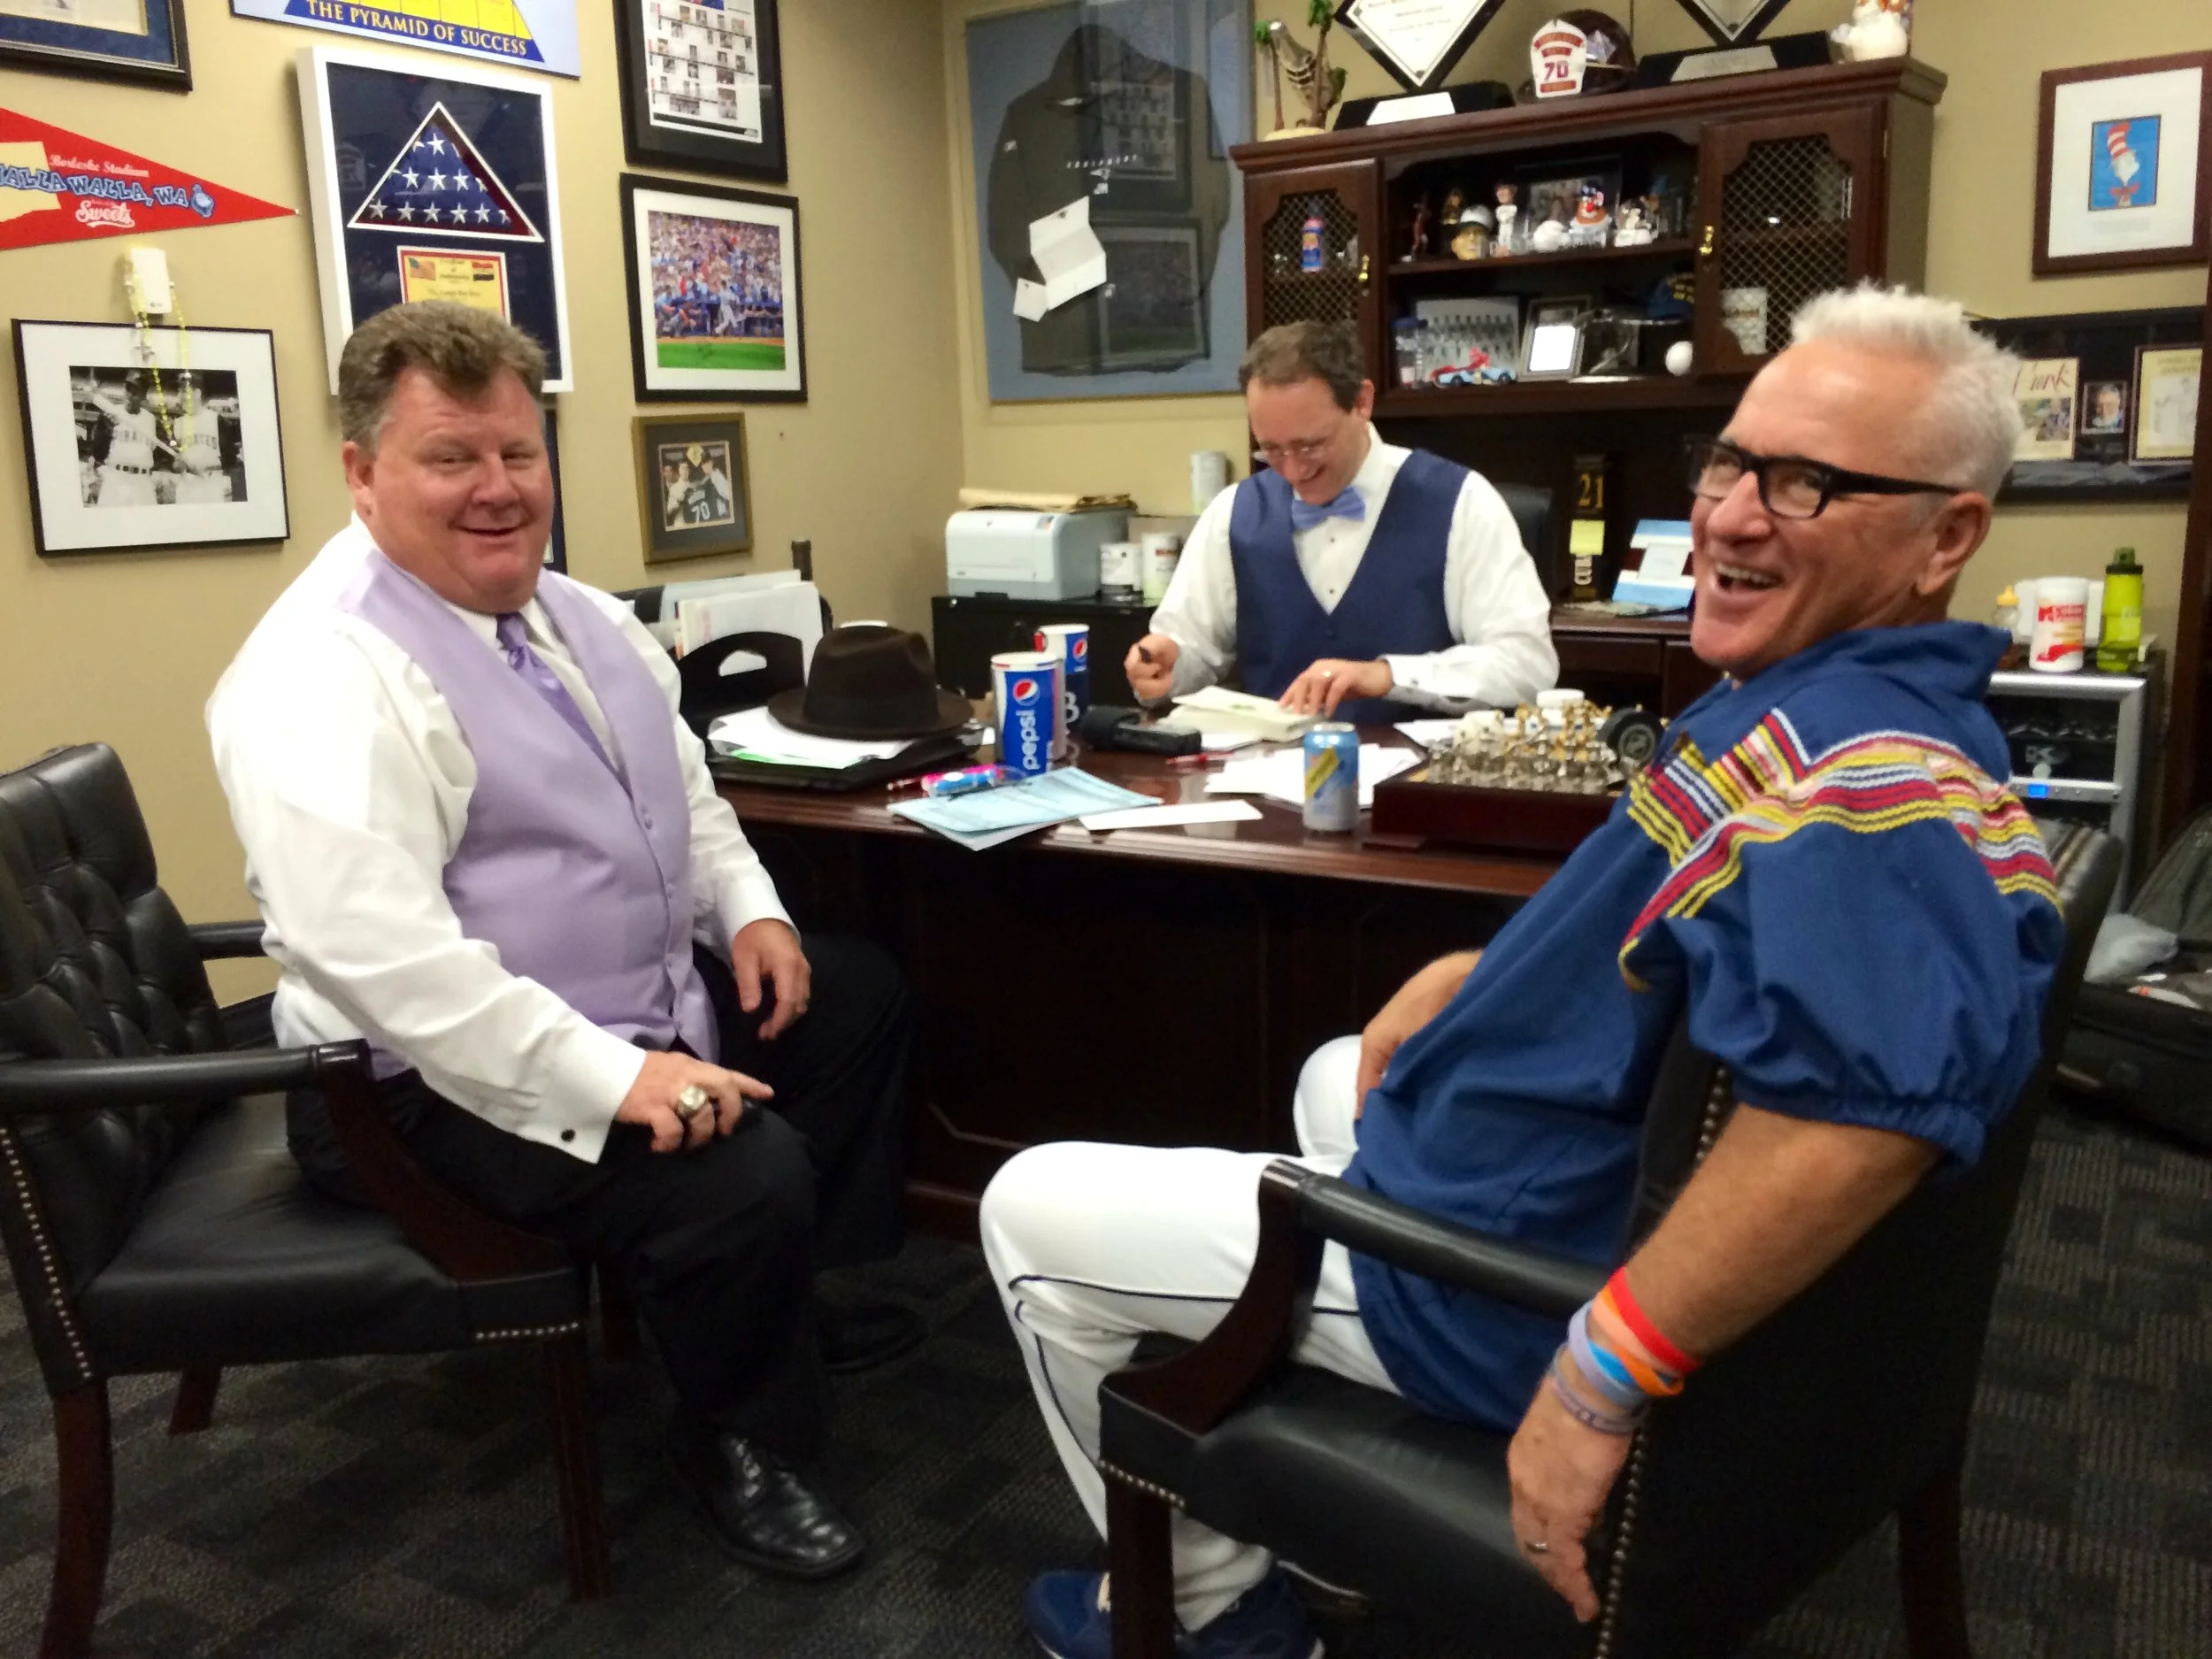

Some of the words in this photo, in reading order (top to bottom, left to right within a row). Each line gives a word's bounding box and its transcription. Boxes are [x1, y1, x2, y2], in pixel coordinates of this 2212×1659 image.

[310, 1, 344, 21] THE
[349, 7, 428, 36] PYRAMID
[433, 24, 456, 42] OF
[460, 28, 528, 57] SUCCESS
[1544, 59, 1570, 81] 70
[0, 163, 68, 194] ALLA
[66, 174, 154, 207] WALLA,
[152, 186, 189, 208] WA
[75, 199, 135, 228] Sweets
[1578, 473, 1604, 509] 21
[690, 501, 710, 524] 70
[1015, 710, 1041, 771] pepsi
